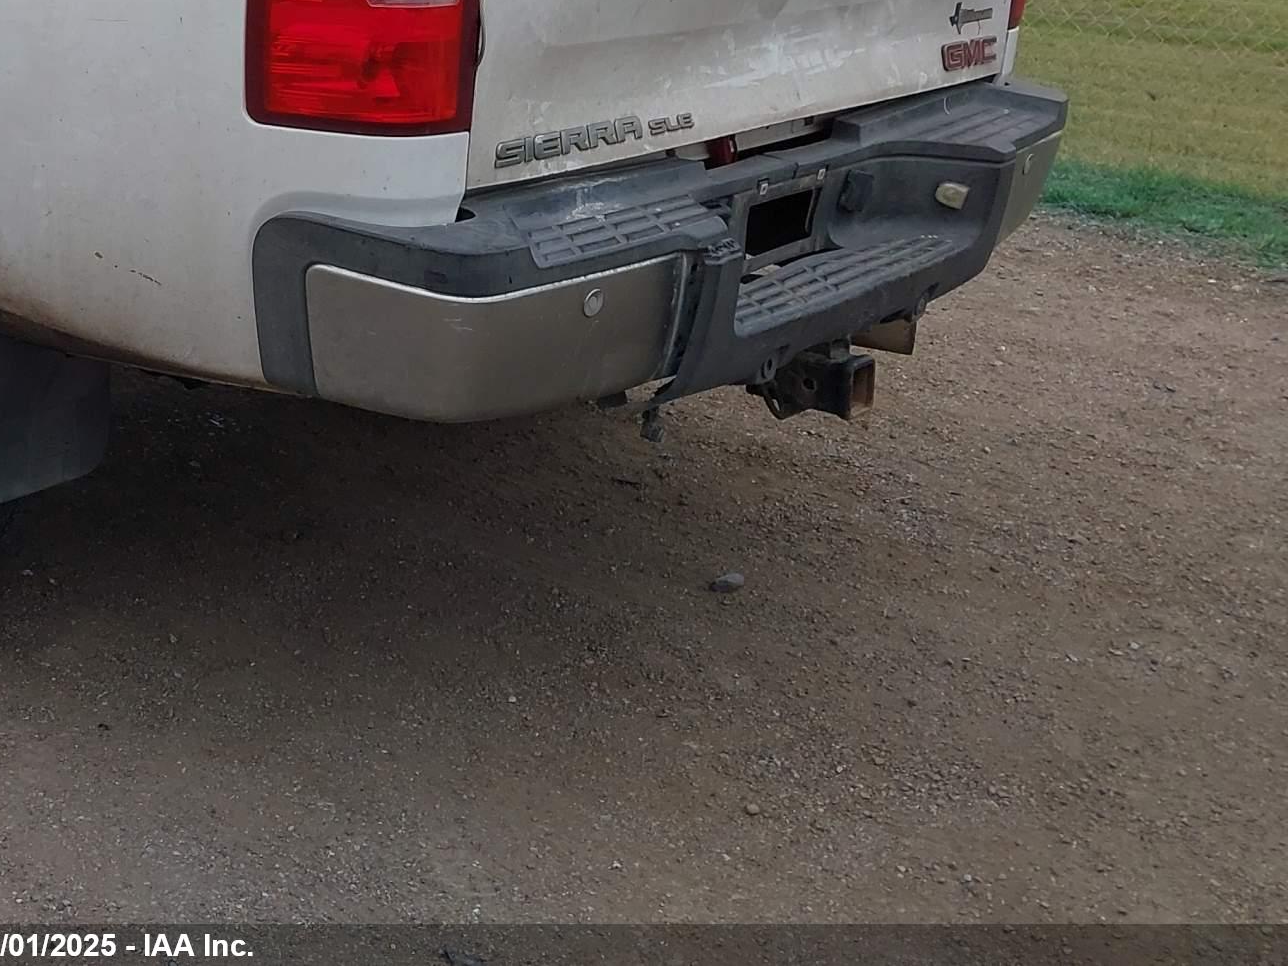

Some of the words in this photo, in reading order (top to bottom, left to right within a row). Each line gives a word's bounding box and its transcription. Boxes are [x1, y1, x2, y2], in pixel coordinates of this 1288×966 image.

[941, 36, 998, 72] GMC
[494, 116, 644, 169] SIERRA
[648, 112, 695, 137] SLE
